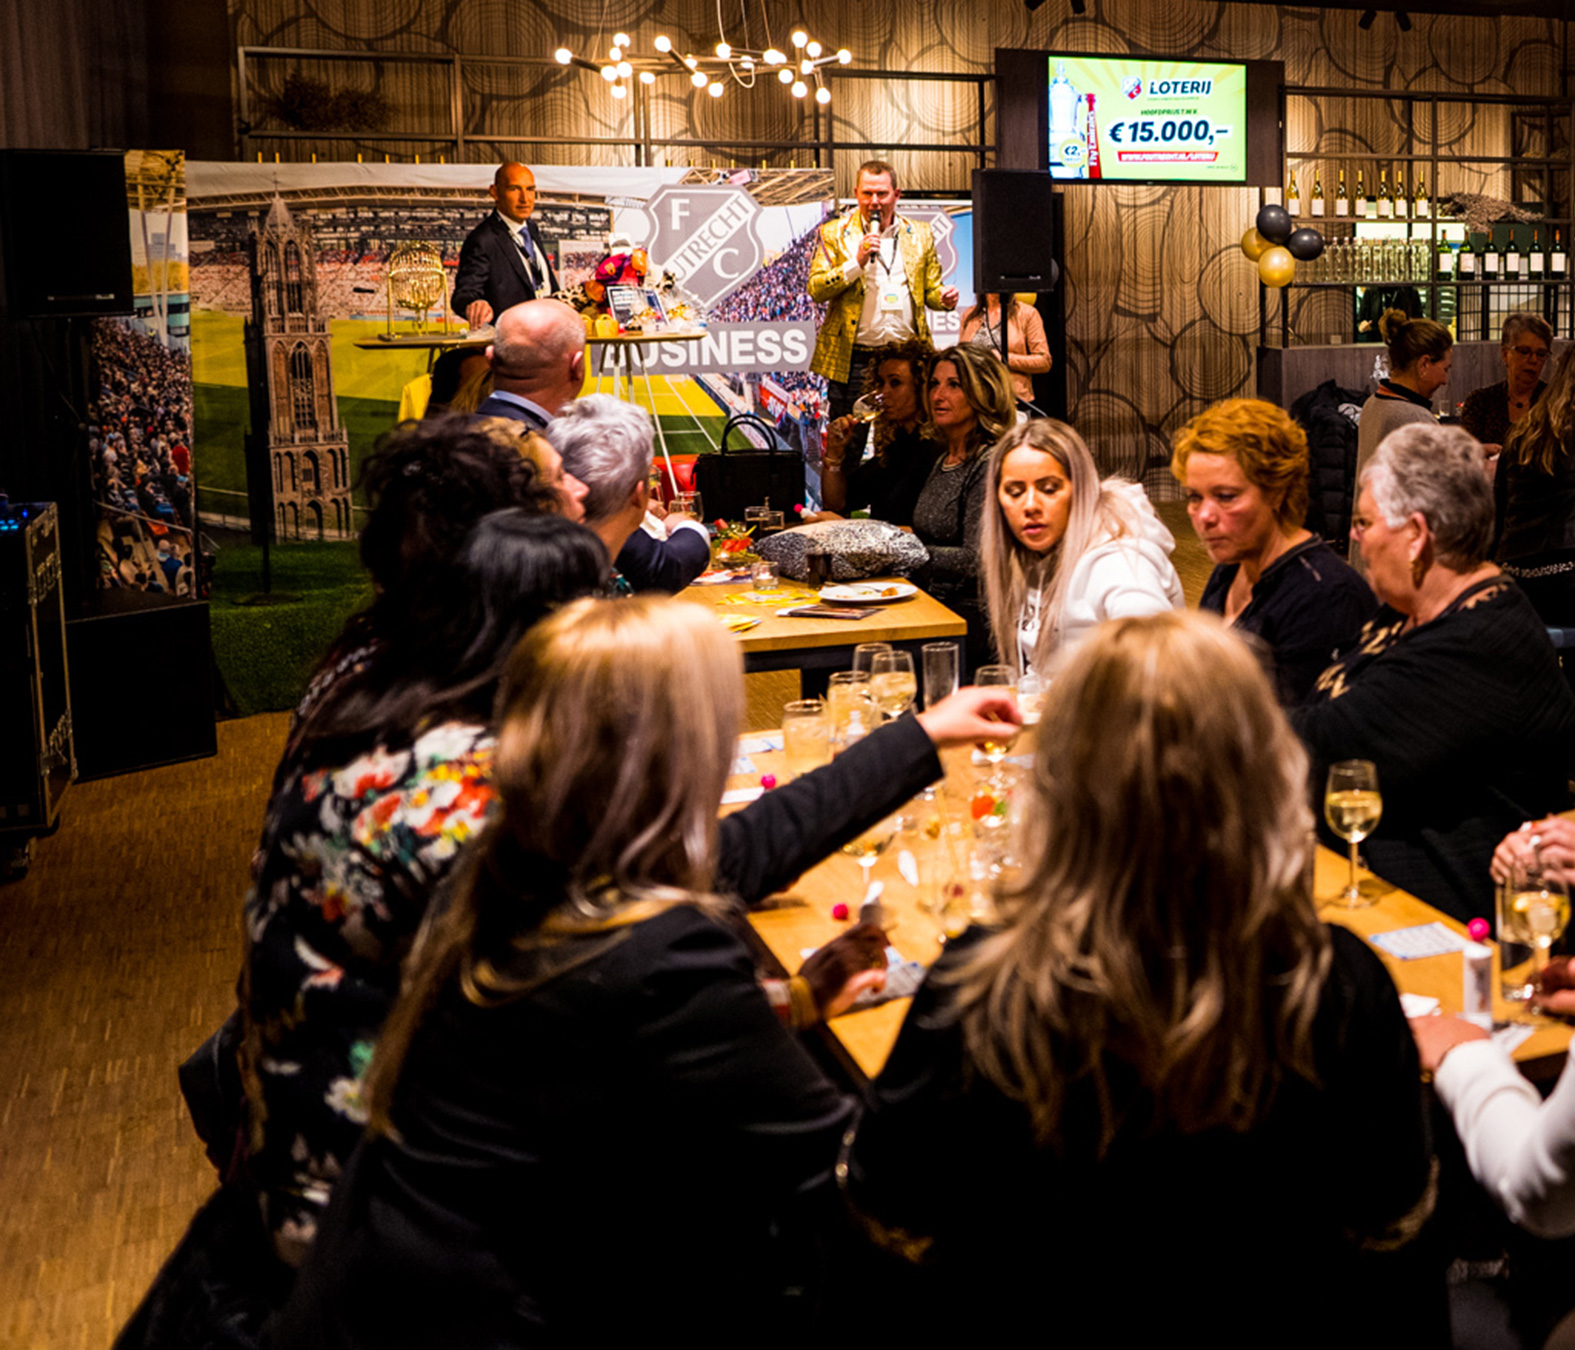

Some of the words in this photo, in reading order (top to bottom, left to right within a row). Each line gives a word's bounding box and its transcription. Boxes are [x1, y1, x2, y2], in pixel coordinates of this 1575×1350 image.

[1149, 80, 1212, 95] LOTERIJ
[1109, 121, 1125, 142] €
[670, 198, 691, 231] F
[673, 195, 751, 282] UTRECHT
[712, 247, 740, 279] C
